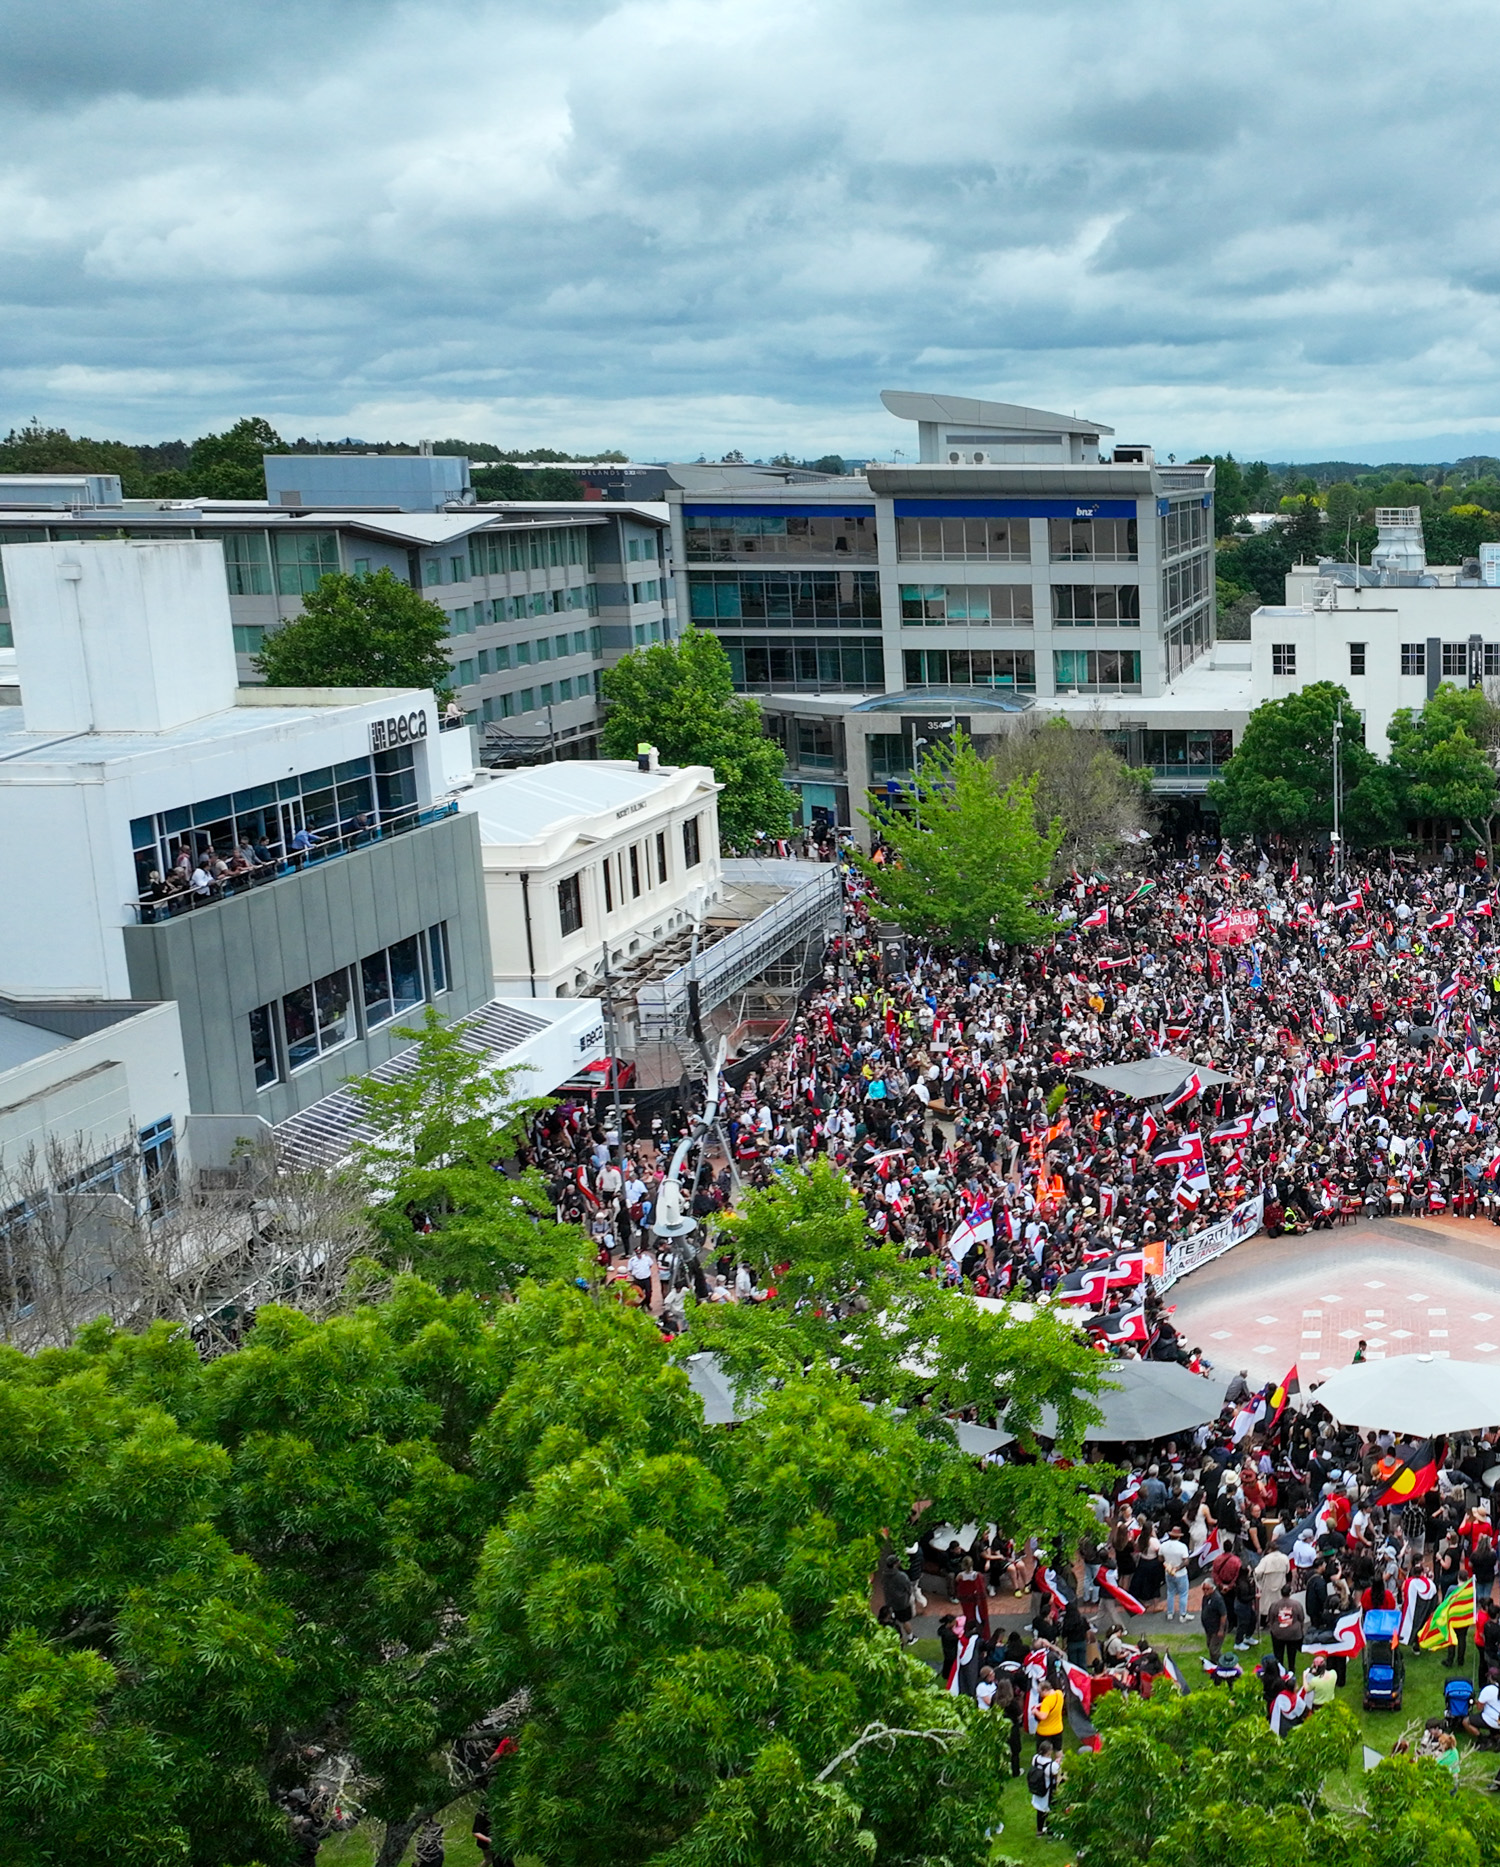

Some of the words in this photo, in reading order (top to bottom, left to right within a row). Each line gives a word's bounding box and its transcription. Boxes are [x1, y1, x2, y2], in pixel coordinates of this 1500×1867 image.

[1076, 506, 1093, 516] bnz
[387, 709, 427, 747] Beca
[927, 721, 944, 730] 354
[585, 1025, 604, 1048] Beca
